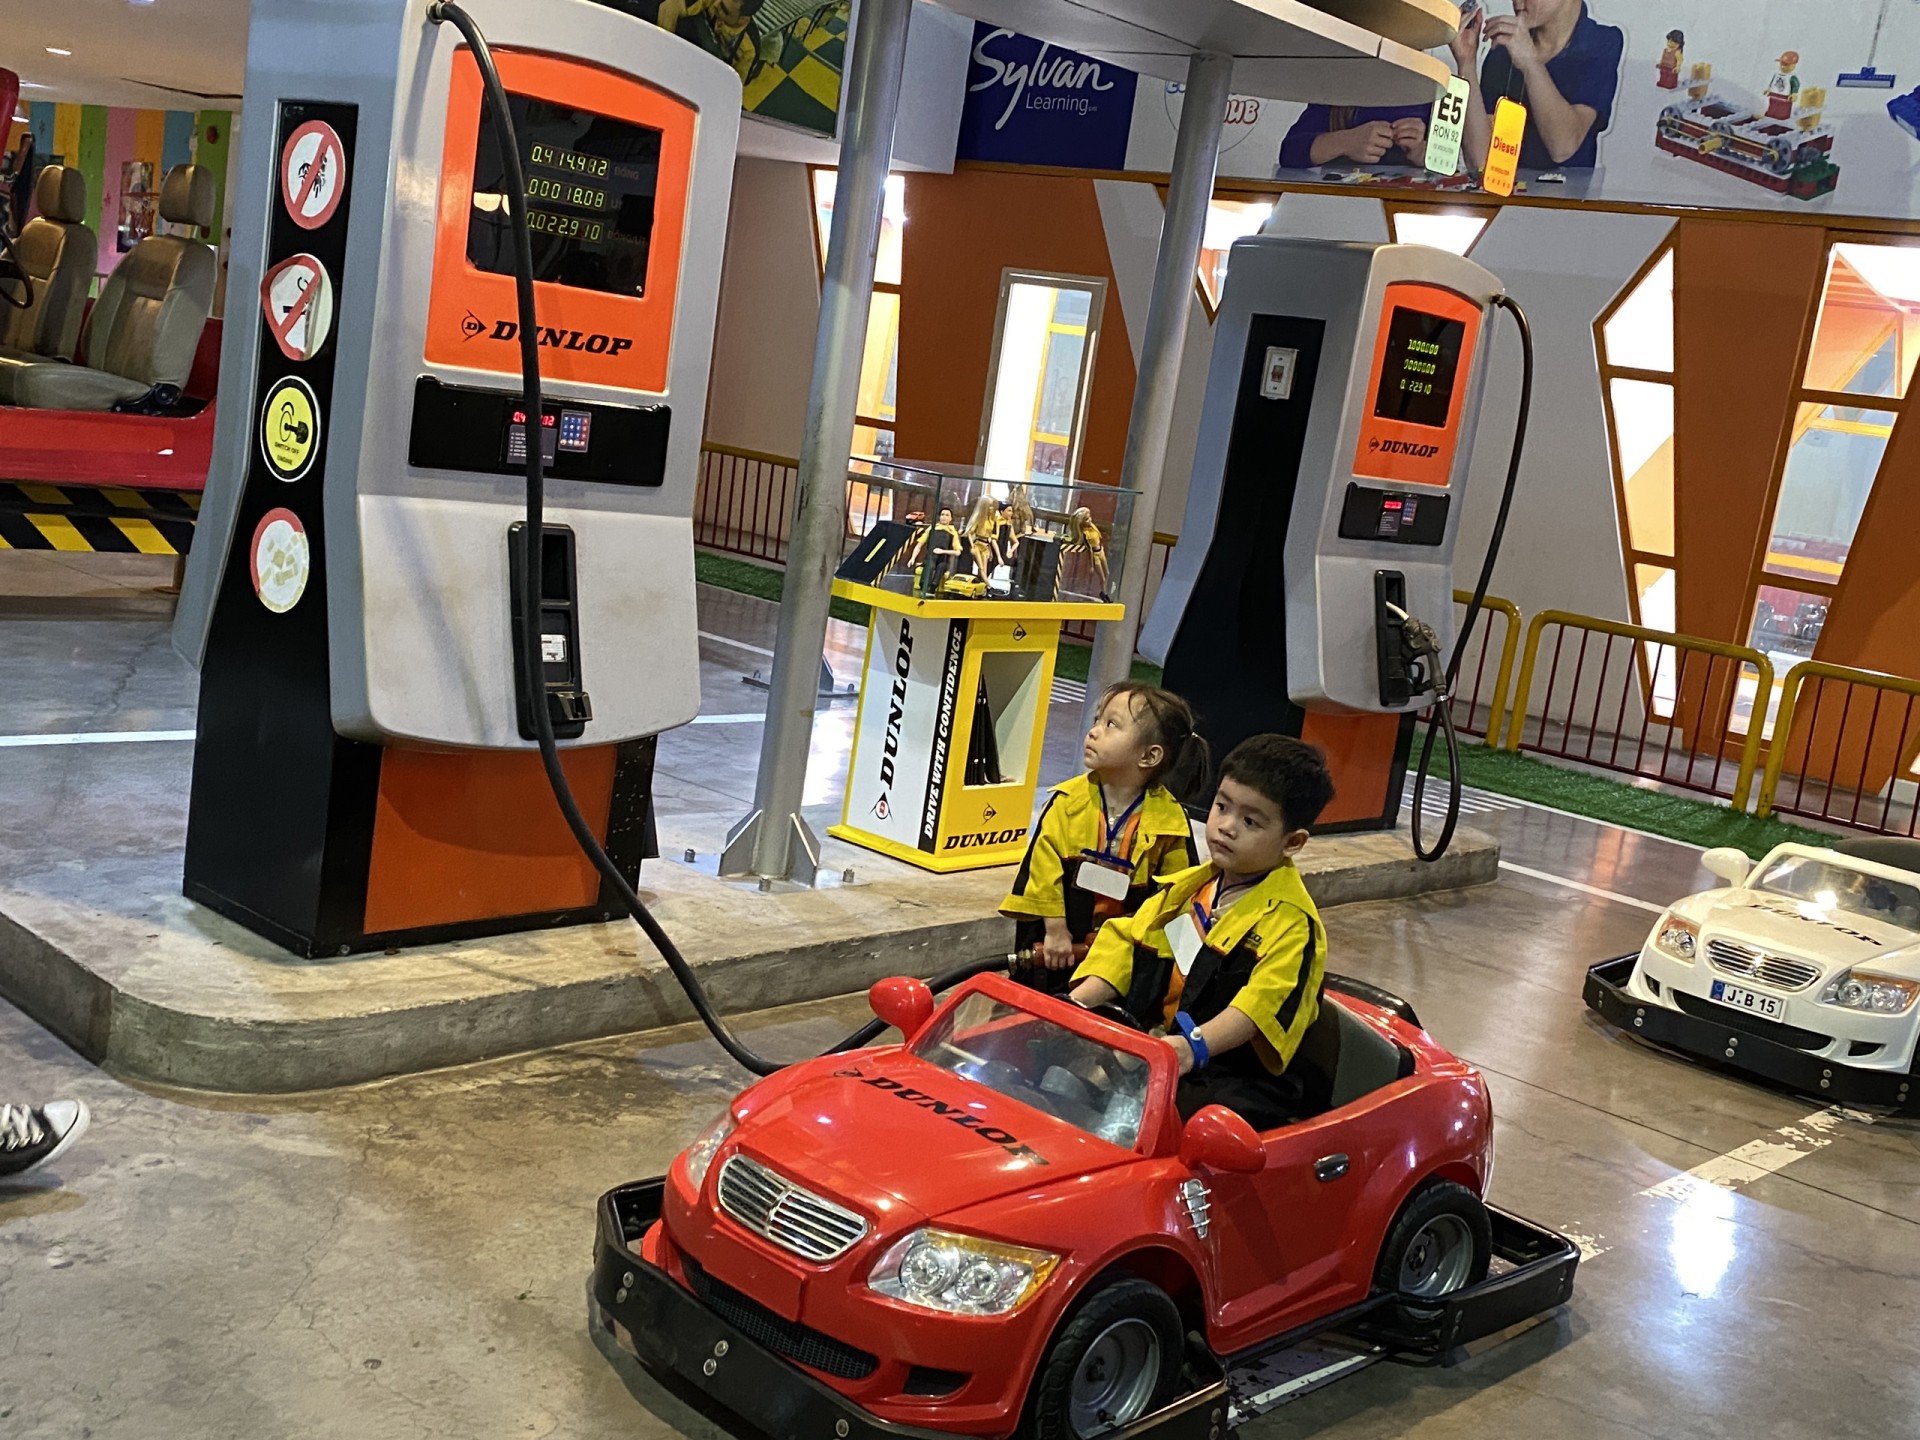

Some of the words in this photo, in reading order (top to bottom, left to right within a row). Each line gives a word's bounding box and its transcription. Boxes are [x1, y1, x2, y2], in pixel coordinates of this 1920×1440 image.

[970, 28, 1114, 130] Sylvan
[1026, 92, 1089, 116] Learning
[1437, 92, 1463, 125] E5
[1432, 124, 1451, 142] RON
[1451, 130, 1460, 144] 92
[1493, 136, 1519, 157] Diesel
[489, 320, 633, 356] DNLOP
[1379, 439, 1439, 458] DUNLOP
[940, 626, 963, 738] CONFIDENCE
[880, 617, 914, 791] DUNLOP
[931, 739, 948, 784] WITH
[924, 782, 941, 840] DRIVE
[942, 827, 1027, 850] DUNLOP
[1759, 997, 1777, 1014] 15
